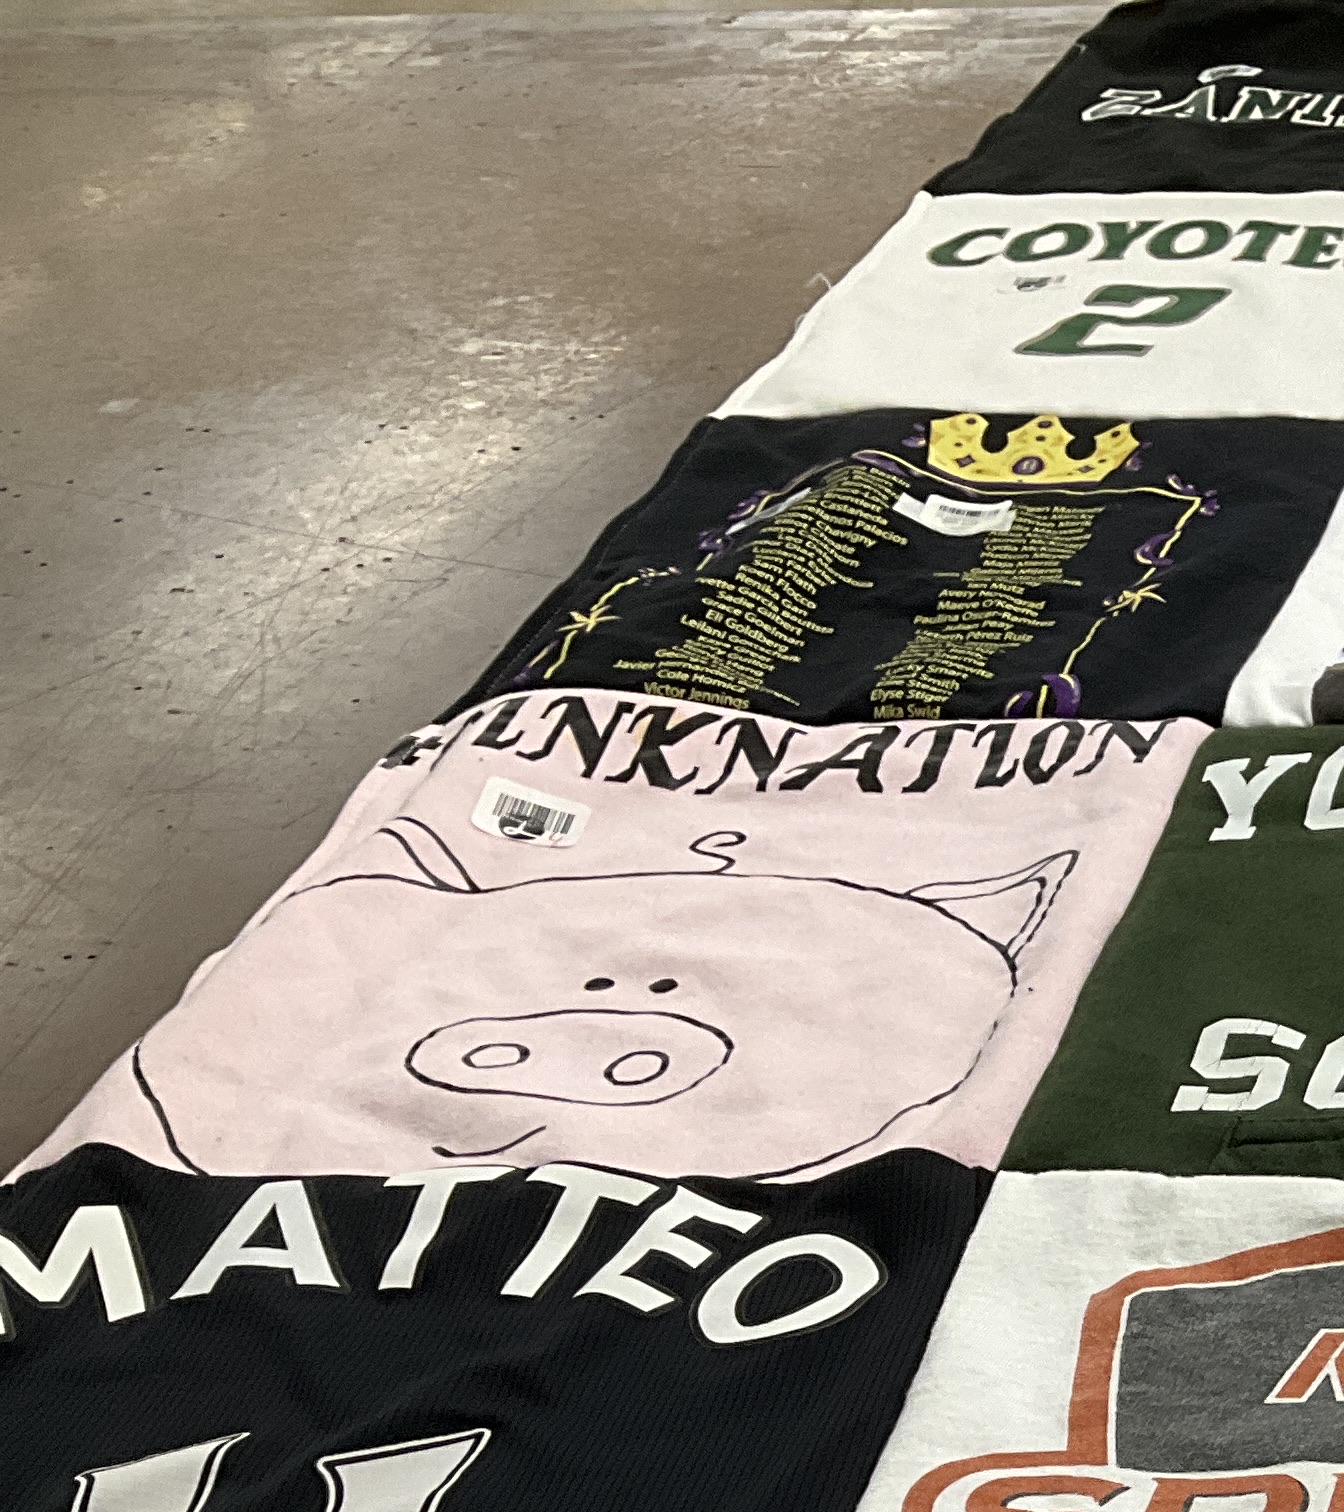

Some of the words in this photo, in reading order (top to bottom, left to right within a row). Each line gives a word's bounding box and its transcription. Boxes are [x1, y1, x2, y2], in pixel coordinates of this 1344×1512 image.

[1012, 283, 1233, 357] 2
[725, 615, 786, 654] Goldberg
[644, 680, 686, 698] Victor
[688, 687, 749, 709] Jennings
[0, 1162, 890, 1346] MATTEO
